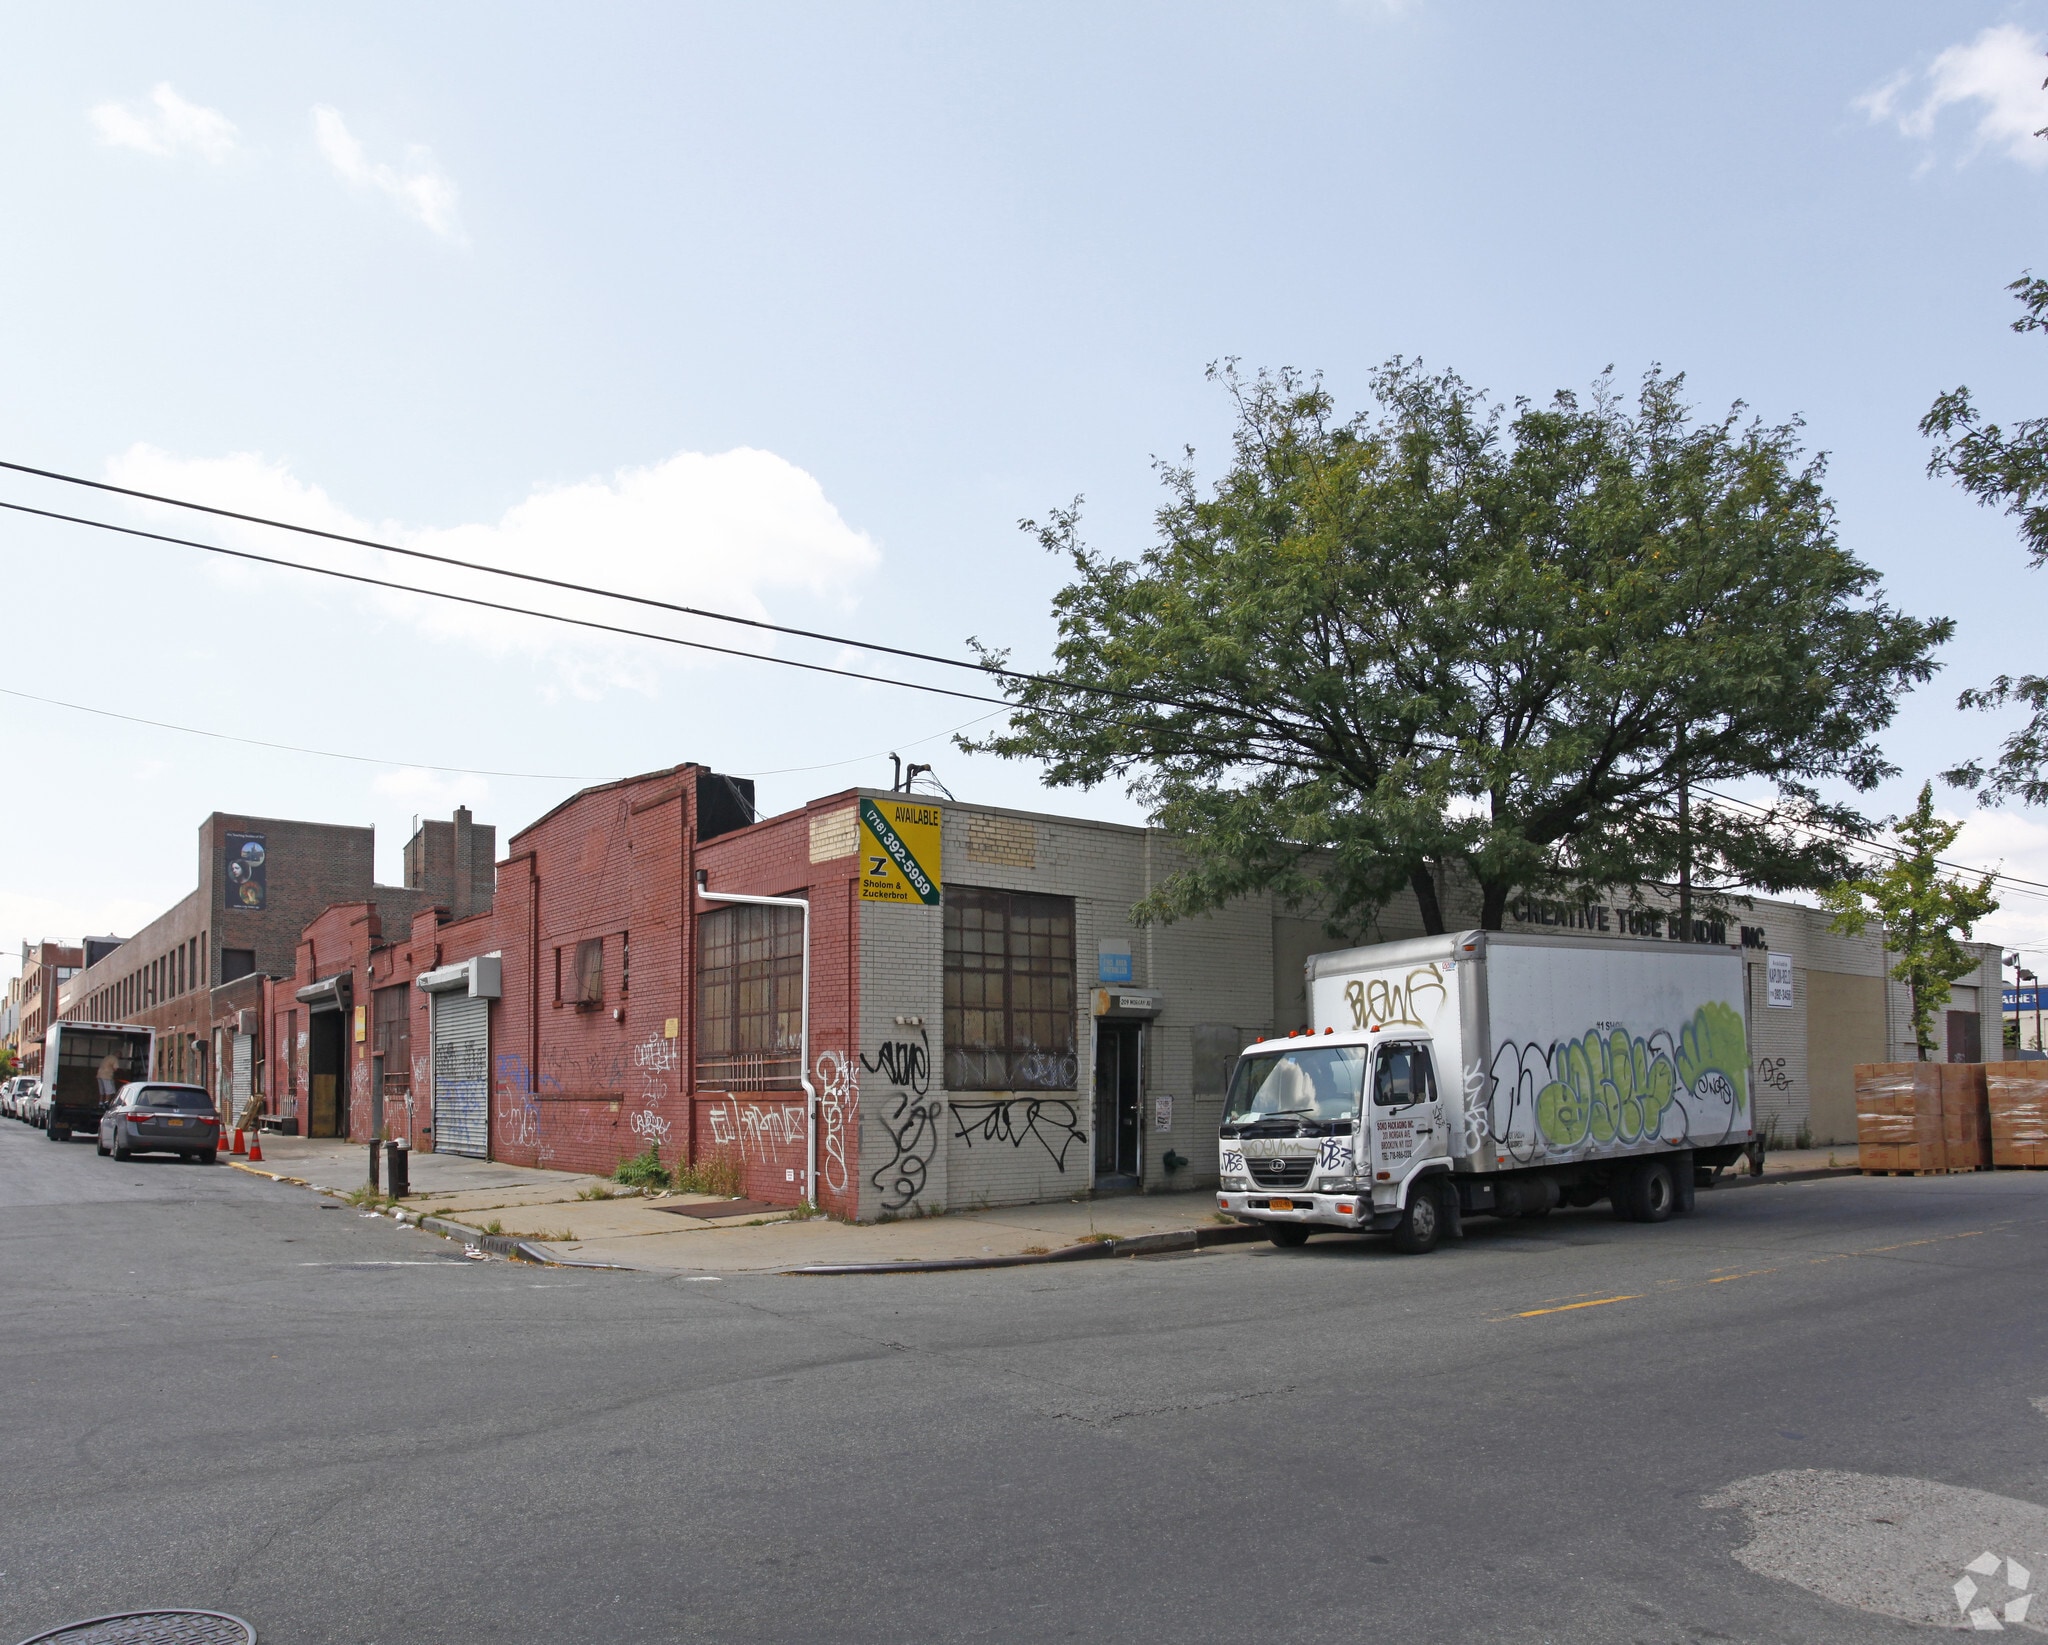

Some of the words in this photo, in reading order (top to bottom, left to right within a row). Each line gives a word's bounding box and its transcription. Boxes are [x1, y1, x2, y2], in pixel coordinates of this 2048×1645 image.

[894, 806, 939, 827] AVAILABLE
[866, 809, 887, 835] (718)
[883, 832, 931, 896] 392-5959
[863, 879, 894, 889] Sholom
[895, 881, 902, 890] &
[862, 889, 908, 900] Zuckerbrot
[1387, 1120, 1407, 1130] PACKAGING
